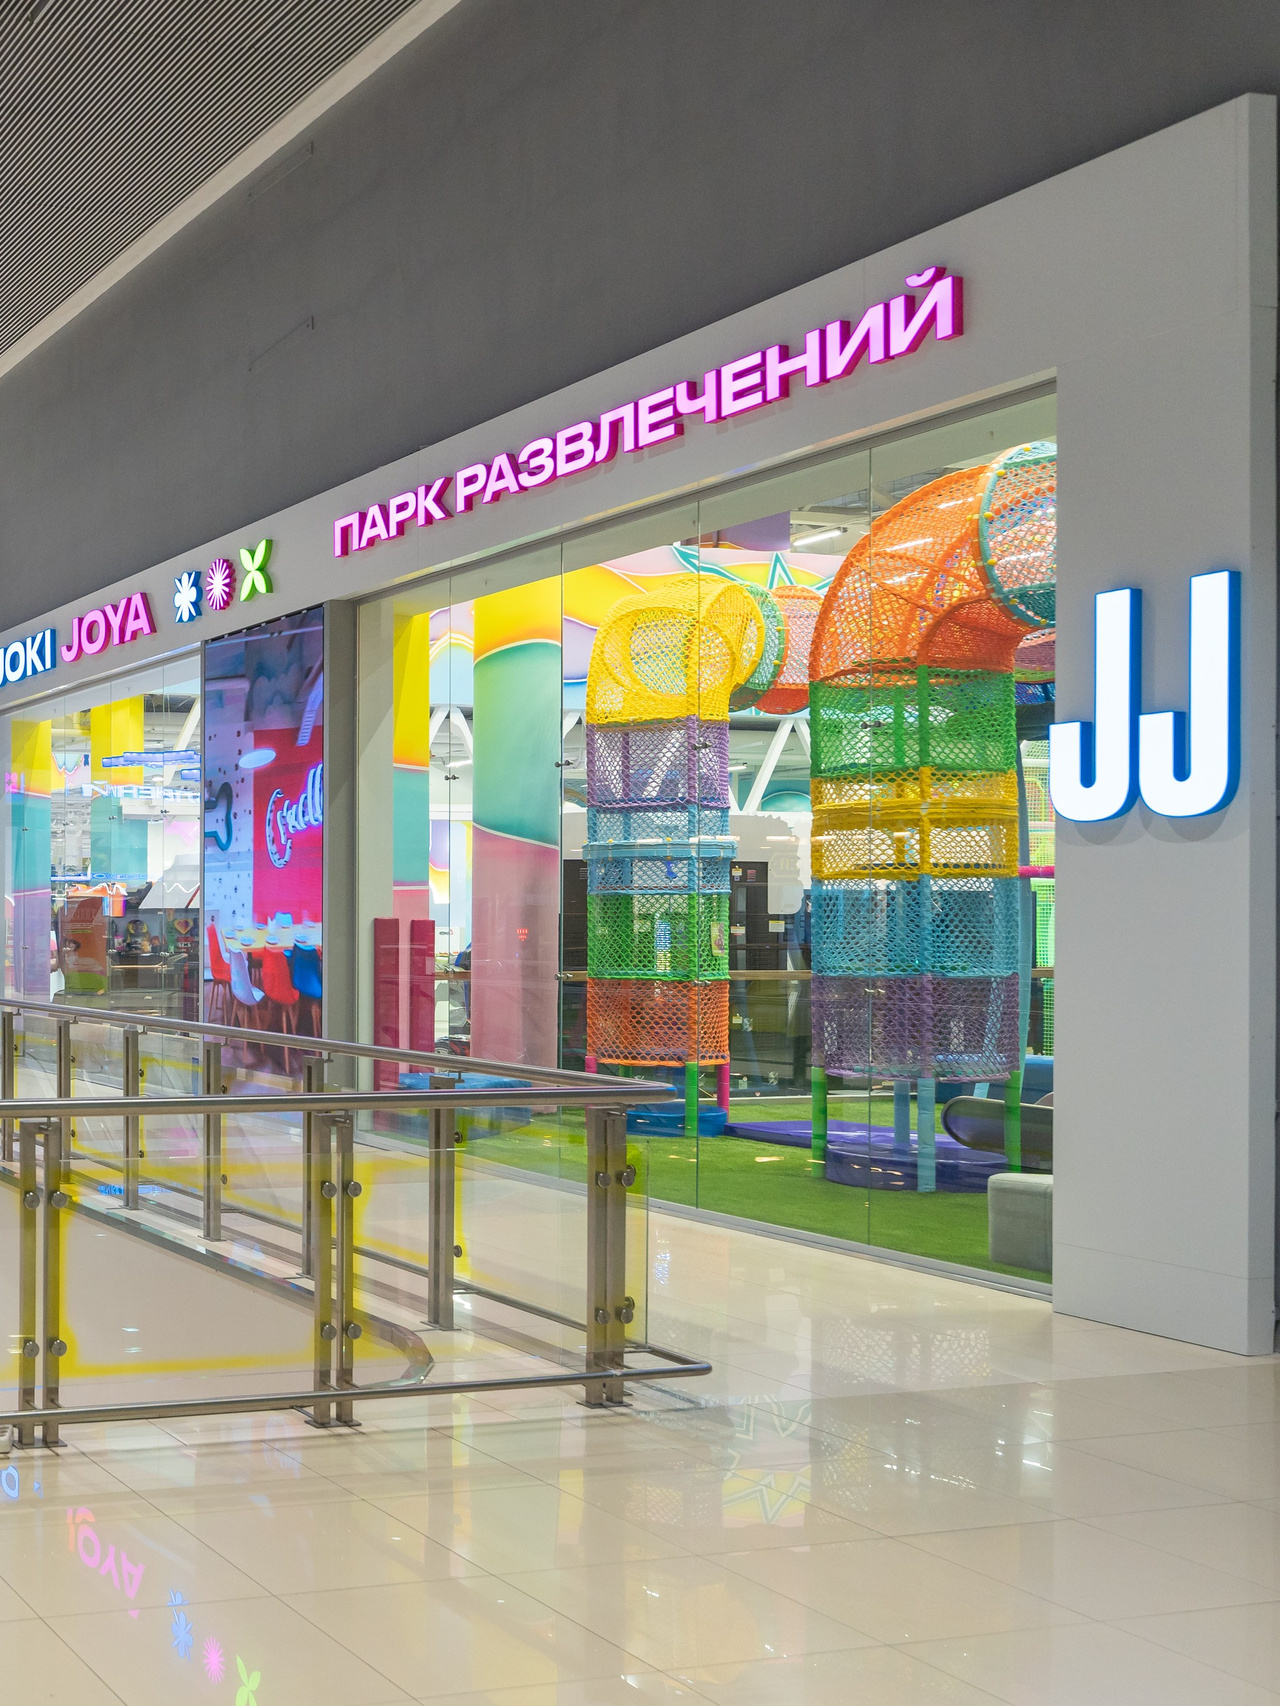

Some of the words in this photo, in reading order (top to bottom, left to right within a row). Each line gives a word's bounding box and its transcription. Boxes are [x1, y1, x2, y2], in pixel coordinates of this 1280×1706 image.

[333, 475, 454, 557] ПАРК
[456, 266, 964, 514] РАЗВЛЕЧЕНИЙ
[61, 592, 156, 663] JOYA
